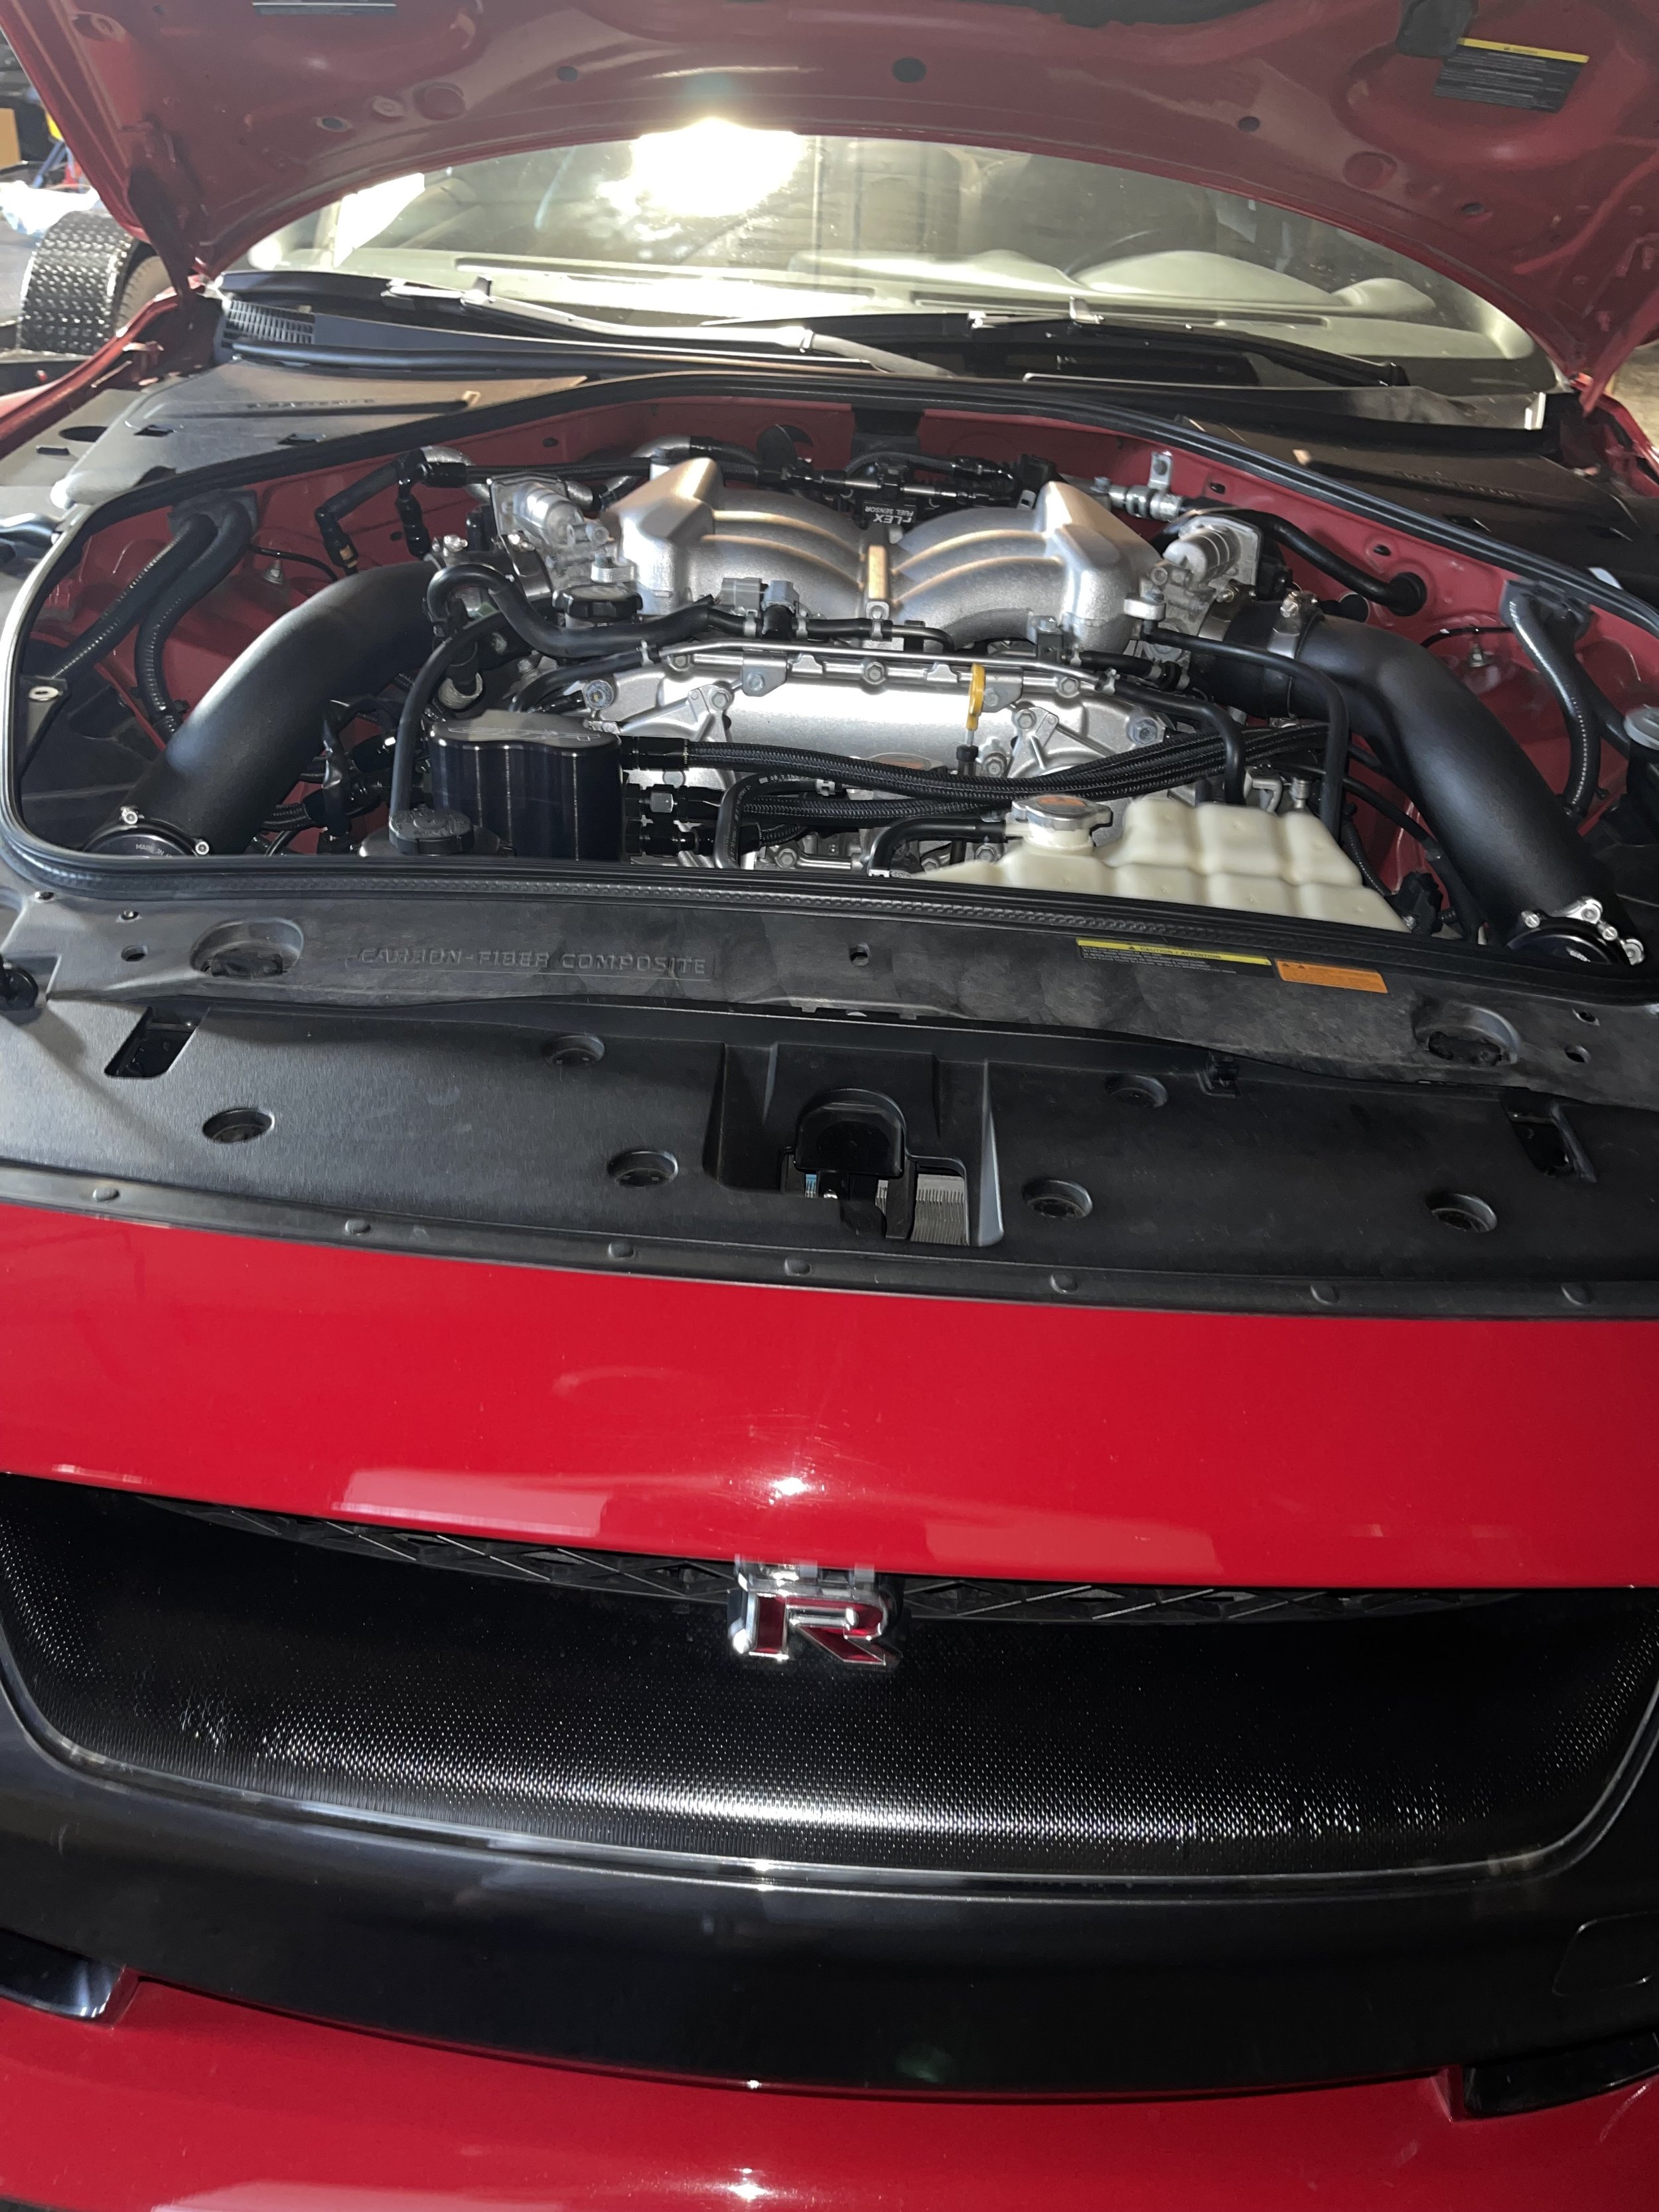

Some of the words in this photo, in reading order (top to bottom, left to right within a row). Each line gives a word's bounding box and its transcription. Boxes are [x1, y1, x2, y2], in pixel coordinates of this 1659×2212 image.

[359, 947, 550, 967] CARBON-FIBER
[561, 952, 707, 974] COMPOSITE
[1139, 946, 1173, 954] CAUTION
[1181, 950, 1222, 959] ATTENTION
